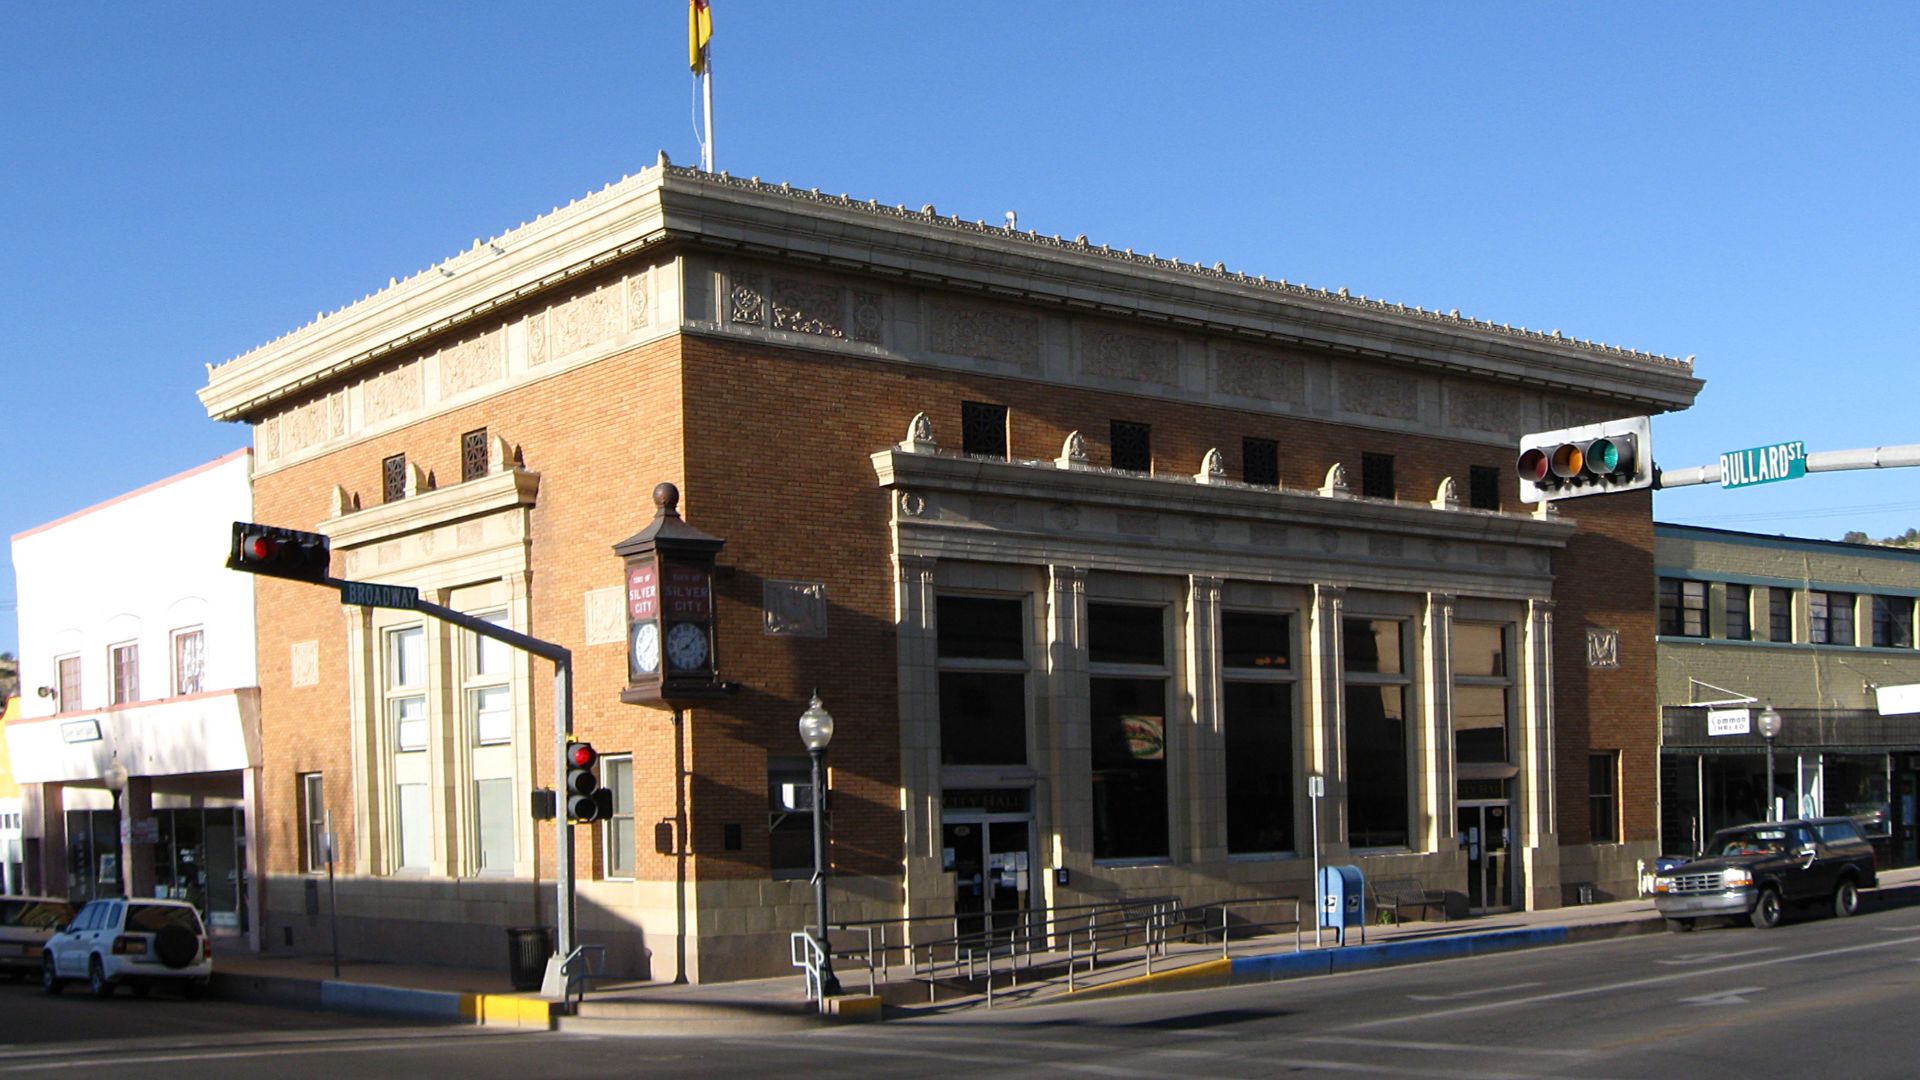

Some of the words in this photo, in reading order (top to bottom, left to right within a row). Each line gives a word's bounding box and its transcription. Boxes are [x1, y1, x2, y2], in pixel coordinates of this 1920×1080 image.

[1720, 445, 1789, 487] BULLARD
[1788, 442, 1805, 461] ST.
[349, 584, 417, 609] BROADWAY
[629, 585, 656, 601] SILVER
[664, 585, 709, 598] SILVER
[635, 601, 652, 614] CITY
[674, 600, 702, 613] CITY
